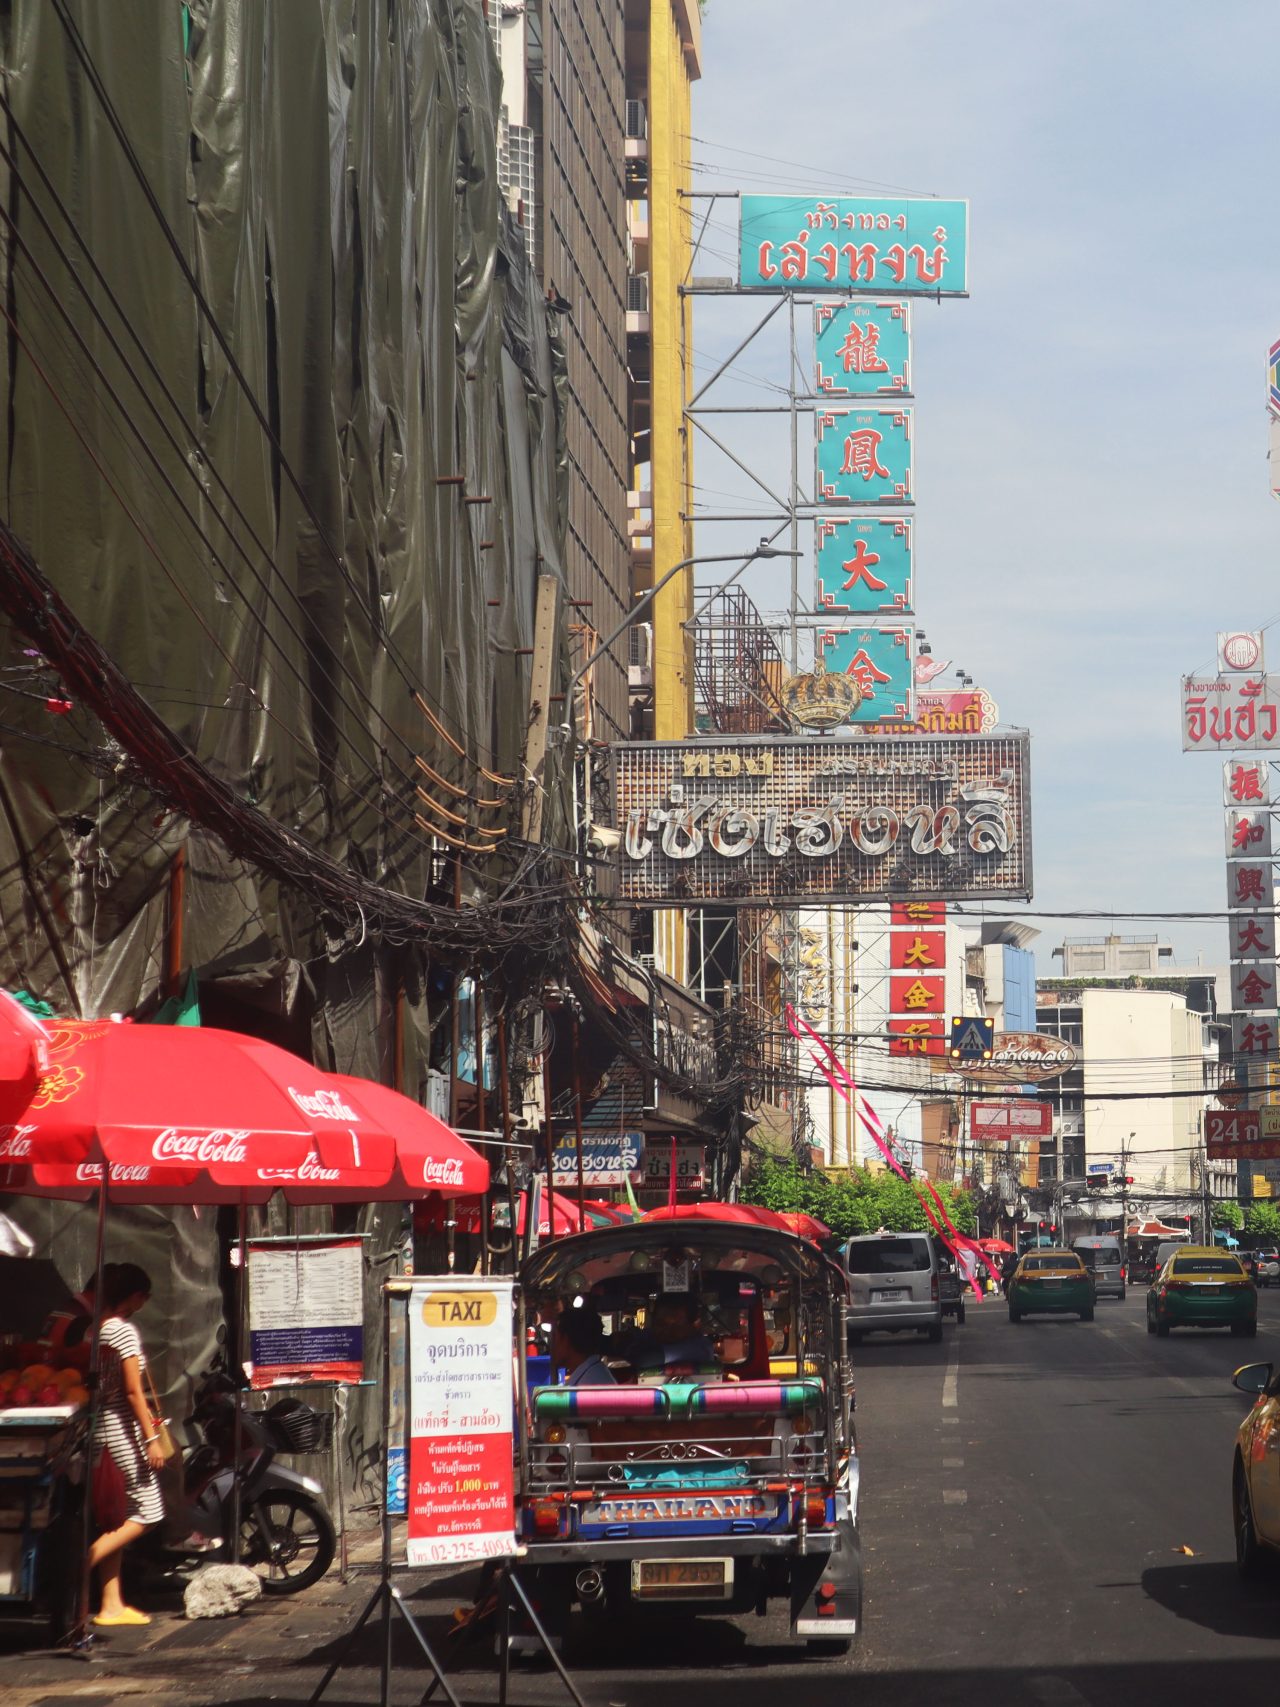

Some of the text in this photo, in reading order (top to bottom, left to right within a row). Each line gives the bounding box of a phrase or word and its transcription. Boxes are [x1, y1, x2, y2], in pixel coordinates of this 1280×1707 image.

[806, 203, 906, 231] ห้างทอง
[758, 226, 948, 284] เล่งหงษ์
[683, 752, 774, 778] ทอง
[288, 1086, 359, 1122] Coca-Cola
[1209, 1118, 1240, 1142] 24
[152, 1128, 250, 1163] Coca-Cola
[423, 1156, 464, 1186] Coca-Cola
[438, 1300, 482, 1322] TAXI
[427, 1337, 488, 1364] จุดบริการ
[483, 1481, 499, 1492] บาท
[598, 1498, 766, 1521] THAILAND
